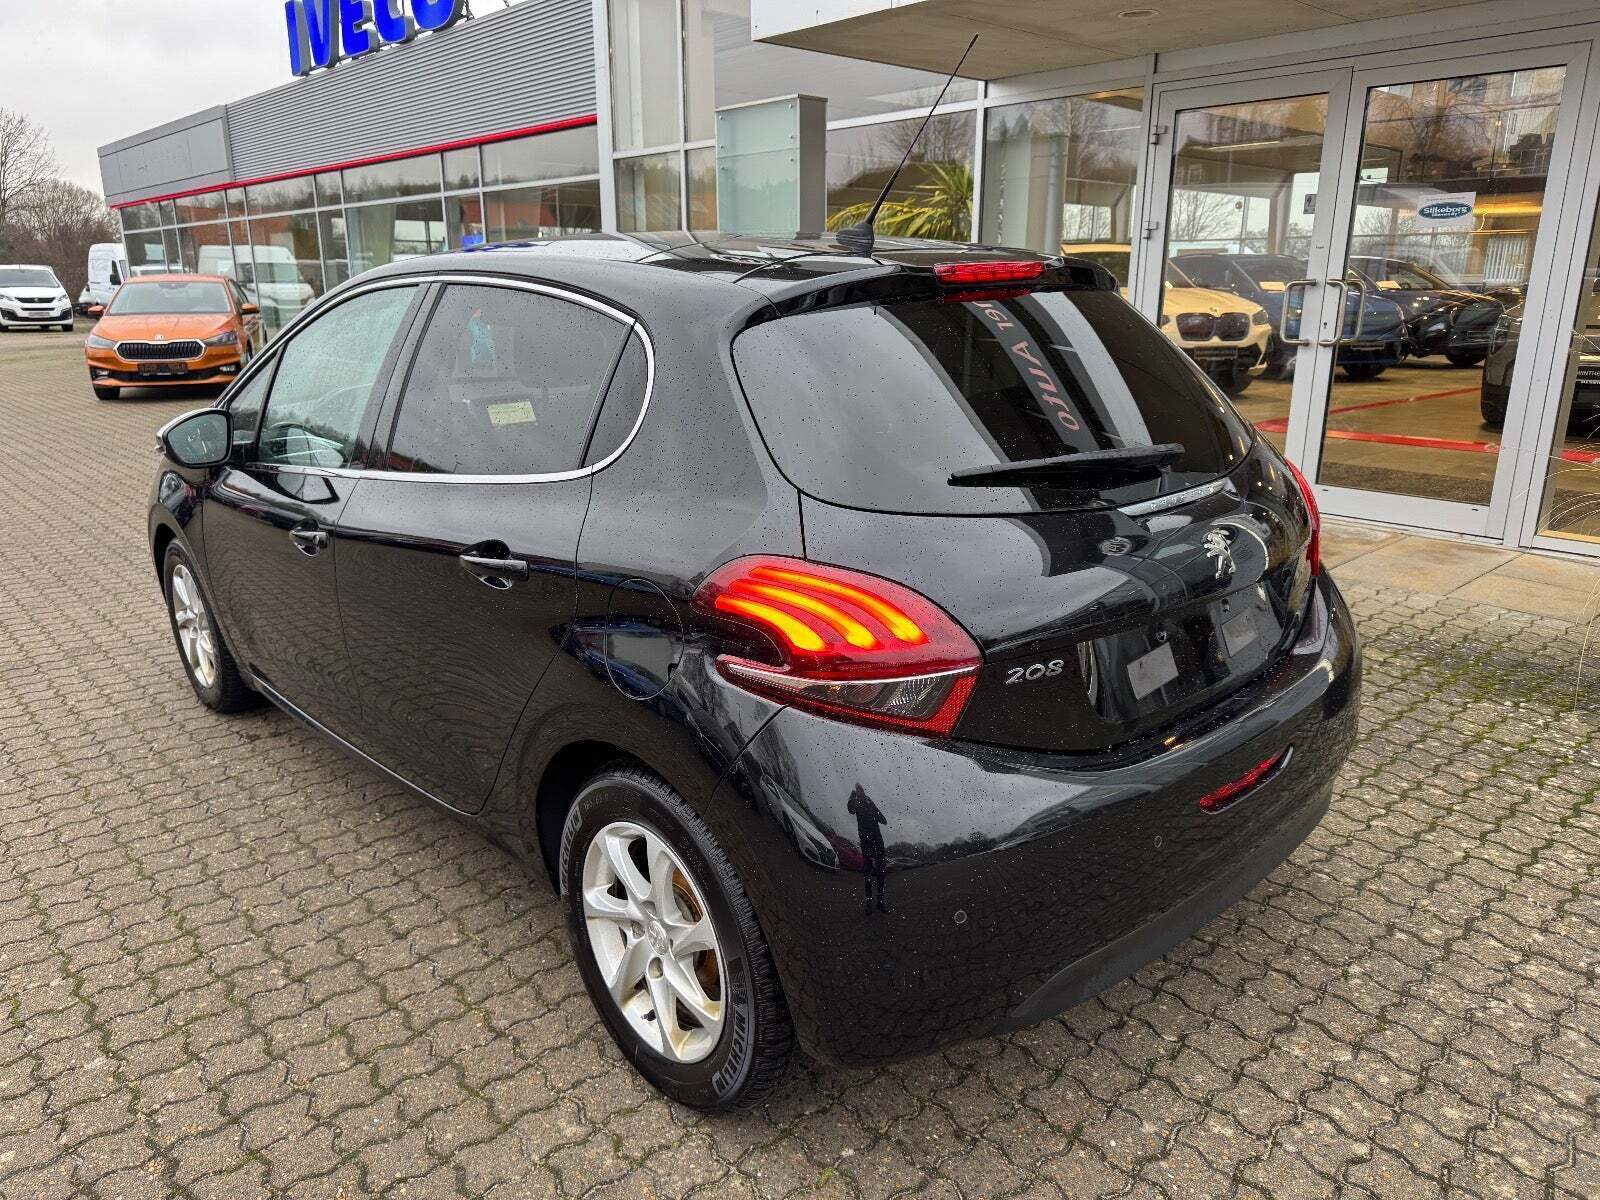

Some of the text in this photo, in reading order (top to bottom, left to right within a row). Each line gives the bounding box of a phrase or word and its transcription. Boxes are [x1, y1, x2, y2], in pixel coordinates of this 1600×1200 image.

[1424, 206, 1468, 214] Silkeborg
[1006, 660, 1065, 685] 208
[714, 1006, 747, 1094] MICHELIN
